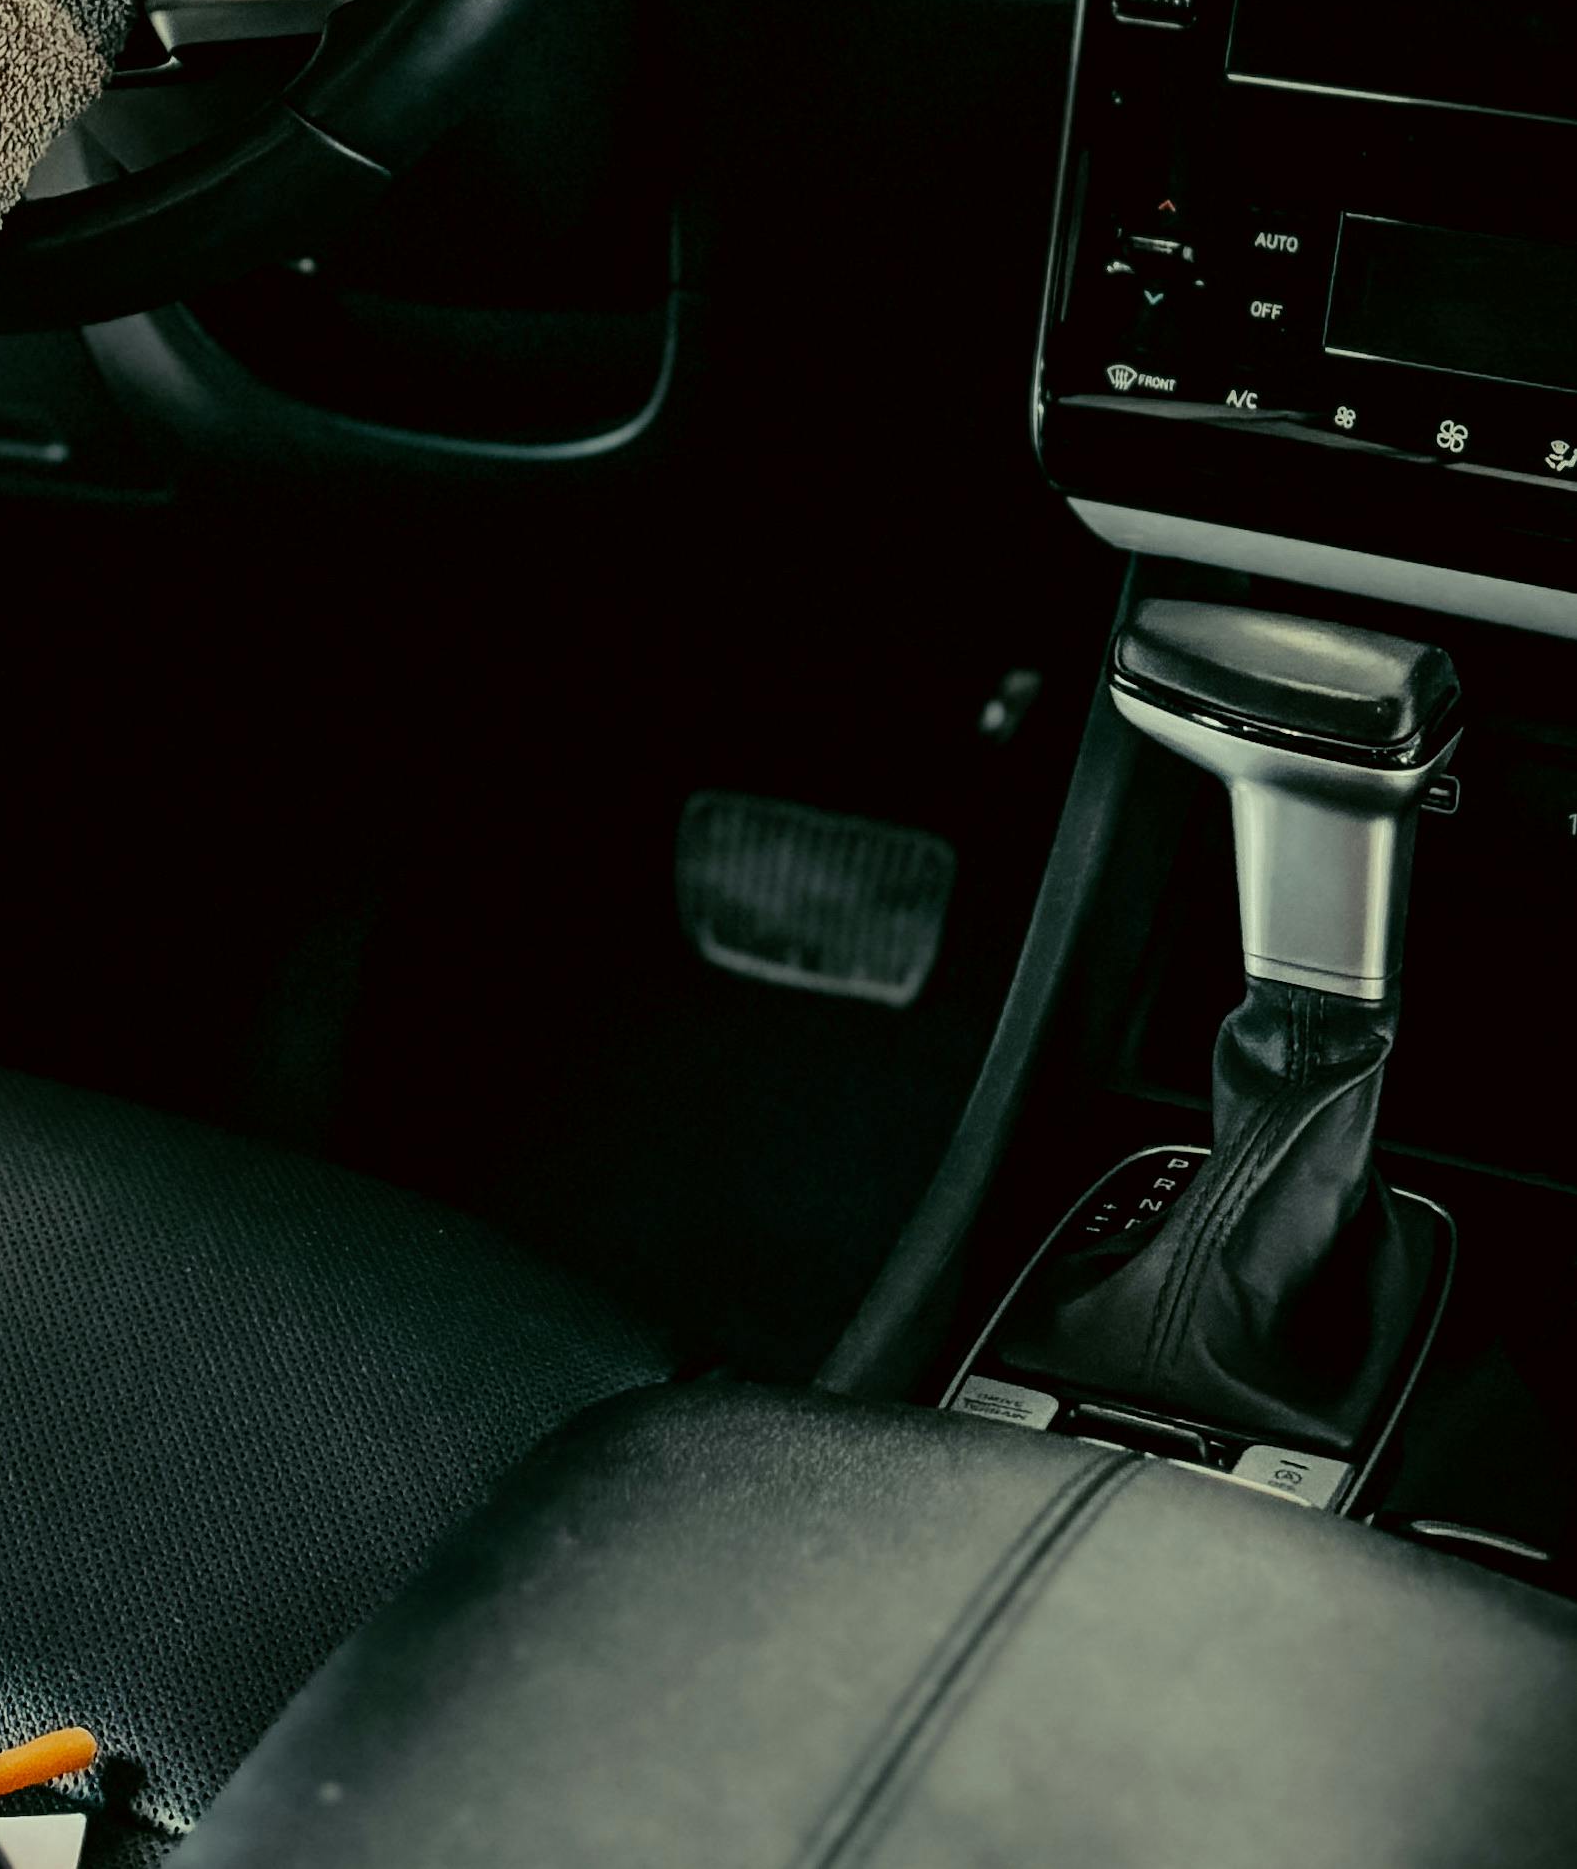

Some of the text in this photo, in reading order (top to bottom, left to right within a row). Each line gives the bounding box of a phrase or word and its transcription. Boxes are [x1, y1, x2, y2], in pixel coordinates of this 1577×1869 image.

[1254, 231, 1300, 254] AUTO
[1250, 300, 1284, 320] OFF
[1137, 373, 1178, 393] FRONT
[1225, 389, 1259, 410] A/C
[1167, 1158, 1189, 1170] P
[1152, 1177, 1177, 1191] R
[1138, 1198, 1164, 1212] N
